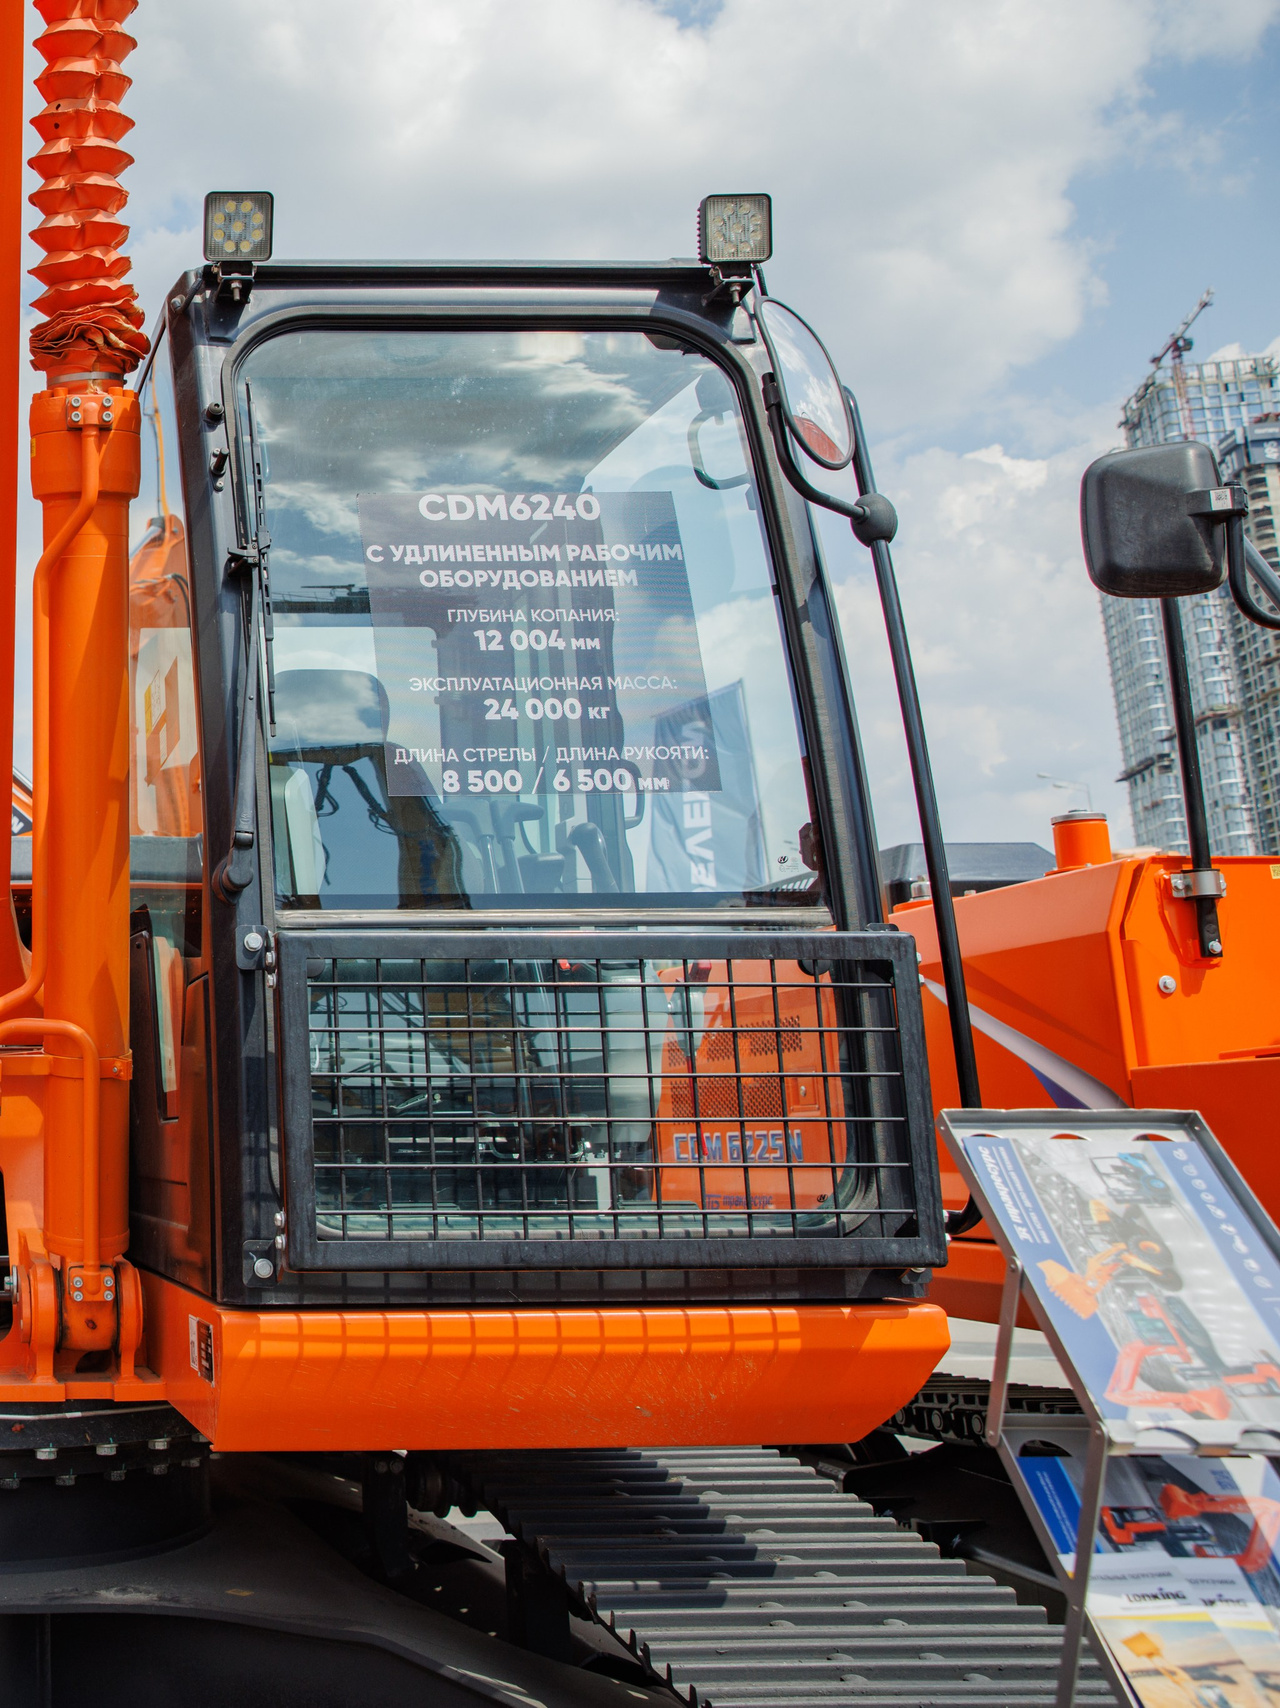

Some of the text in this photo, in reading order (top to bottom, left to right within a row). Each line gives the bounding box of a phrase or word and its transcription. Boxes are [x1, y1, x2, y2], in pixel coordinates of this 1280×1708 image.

[418, 494, 600, 521] CDM6240
[366, 544, 683, 564] С УДЛИНЕННЫМ РАБОЧИМ
[419, 570, 638, 590] ОБОРУДОВАНИЕМ
[448, 609, 620, 623] ГЛУБИНА КОПАНИЯ:
[474, 630, 504, 651] 12
[510, 630, 566, 650] 004
[409, 676, 677, 693] ЭКСПЛУАТАЦИОННАЯ МАССА:
[484, 698, 610, 720] 24 000 кг
[394, 748, 458, 764] ДЛИНА
[463, 748, 536, 762] СТРЕЛЫ
[556, 747, 620, 763] ДЛИНА
[624, 746, 709, 760] РУКОЯТИ:
[442, 770, 460, 793] 8
[468, 770, 522, 792] 500
[553, 769, 570, 792] 6
[577, 768, 632, 791] 500
